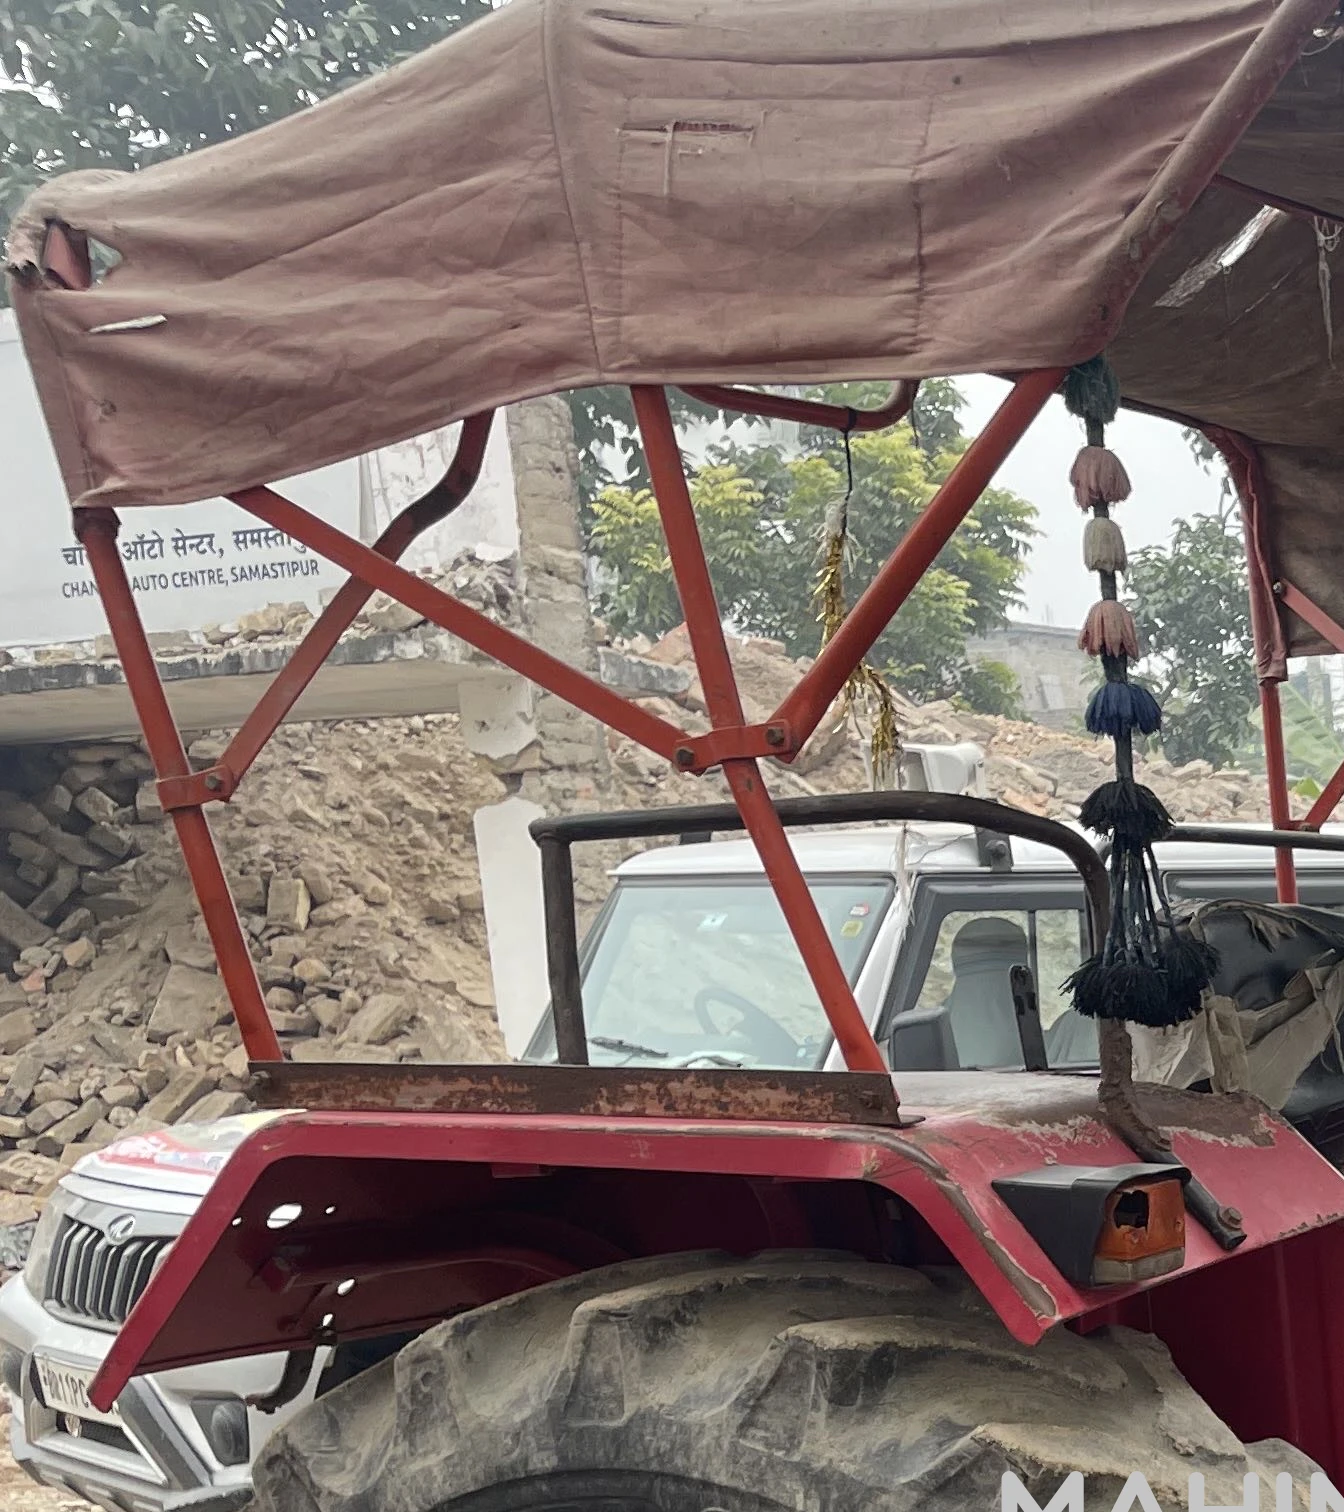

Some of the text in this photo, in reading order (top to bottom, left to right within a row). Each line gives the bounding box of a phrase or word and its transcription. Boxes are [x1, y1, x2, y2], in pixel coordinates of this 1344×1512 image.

[121, 530, 165, 560] ऑटो
[132, 573, 169, 592] AUTO
[171, 567, 229, 589] CENTRE,
[230, 559, 320, 583] SAMASTIPUR
